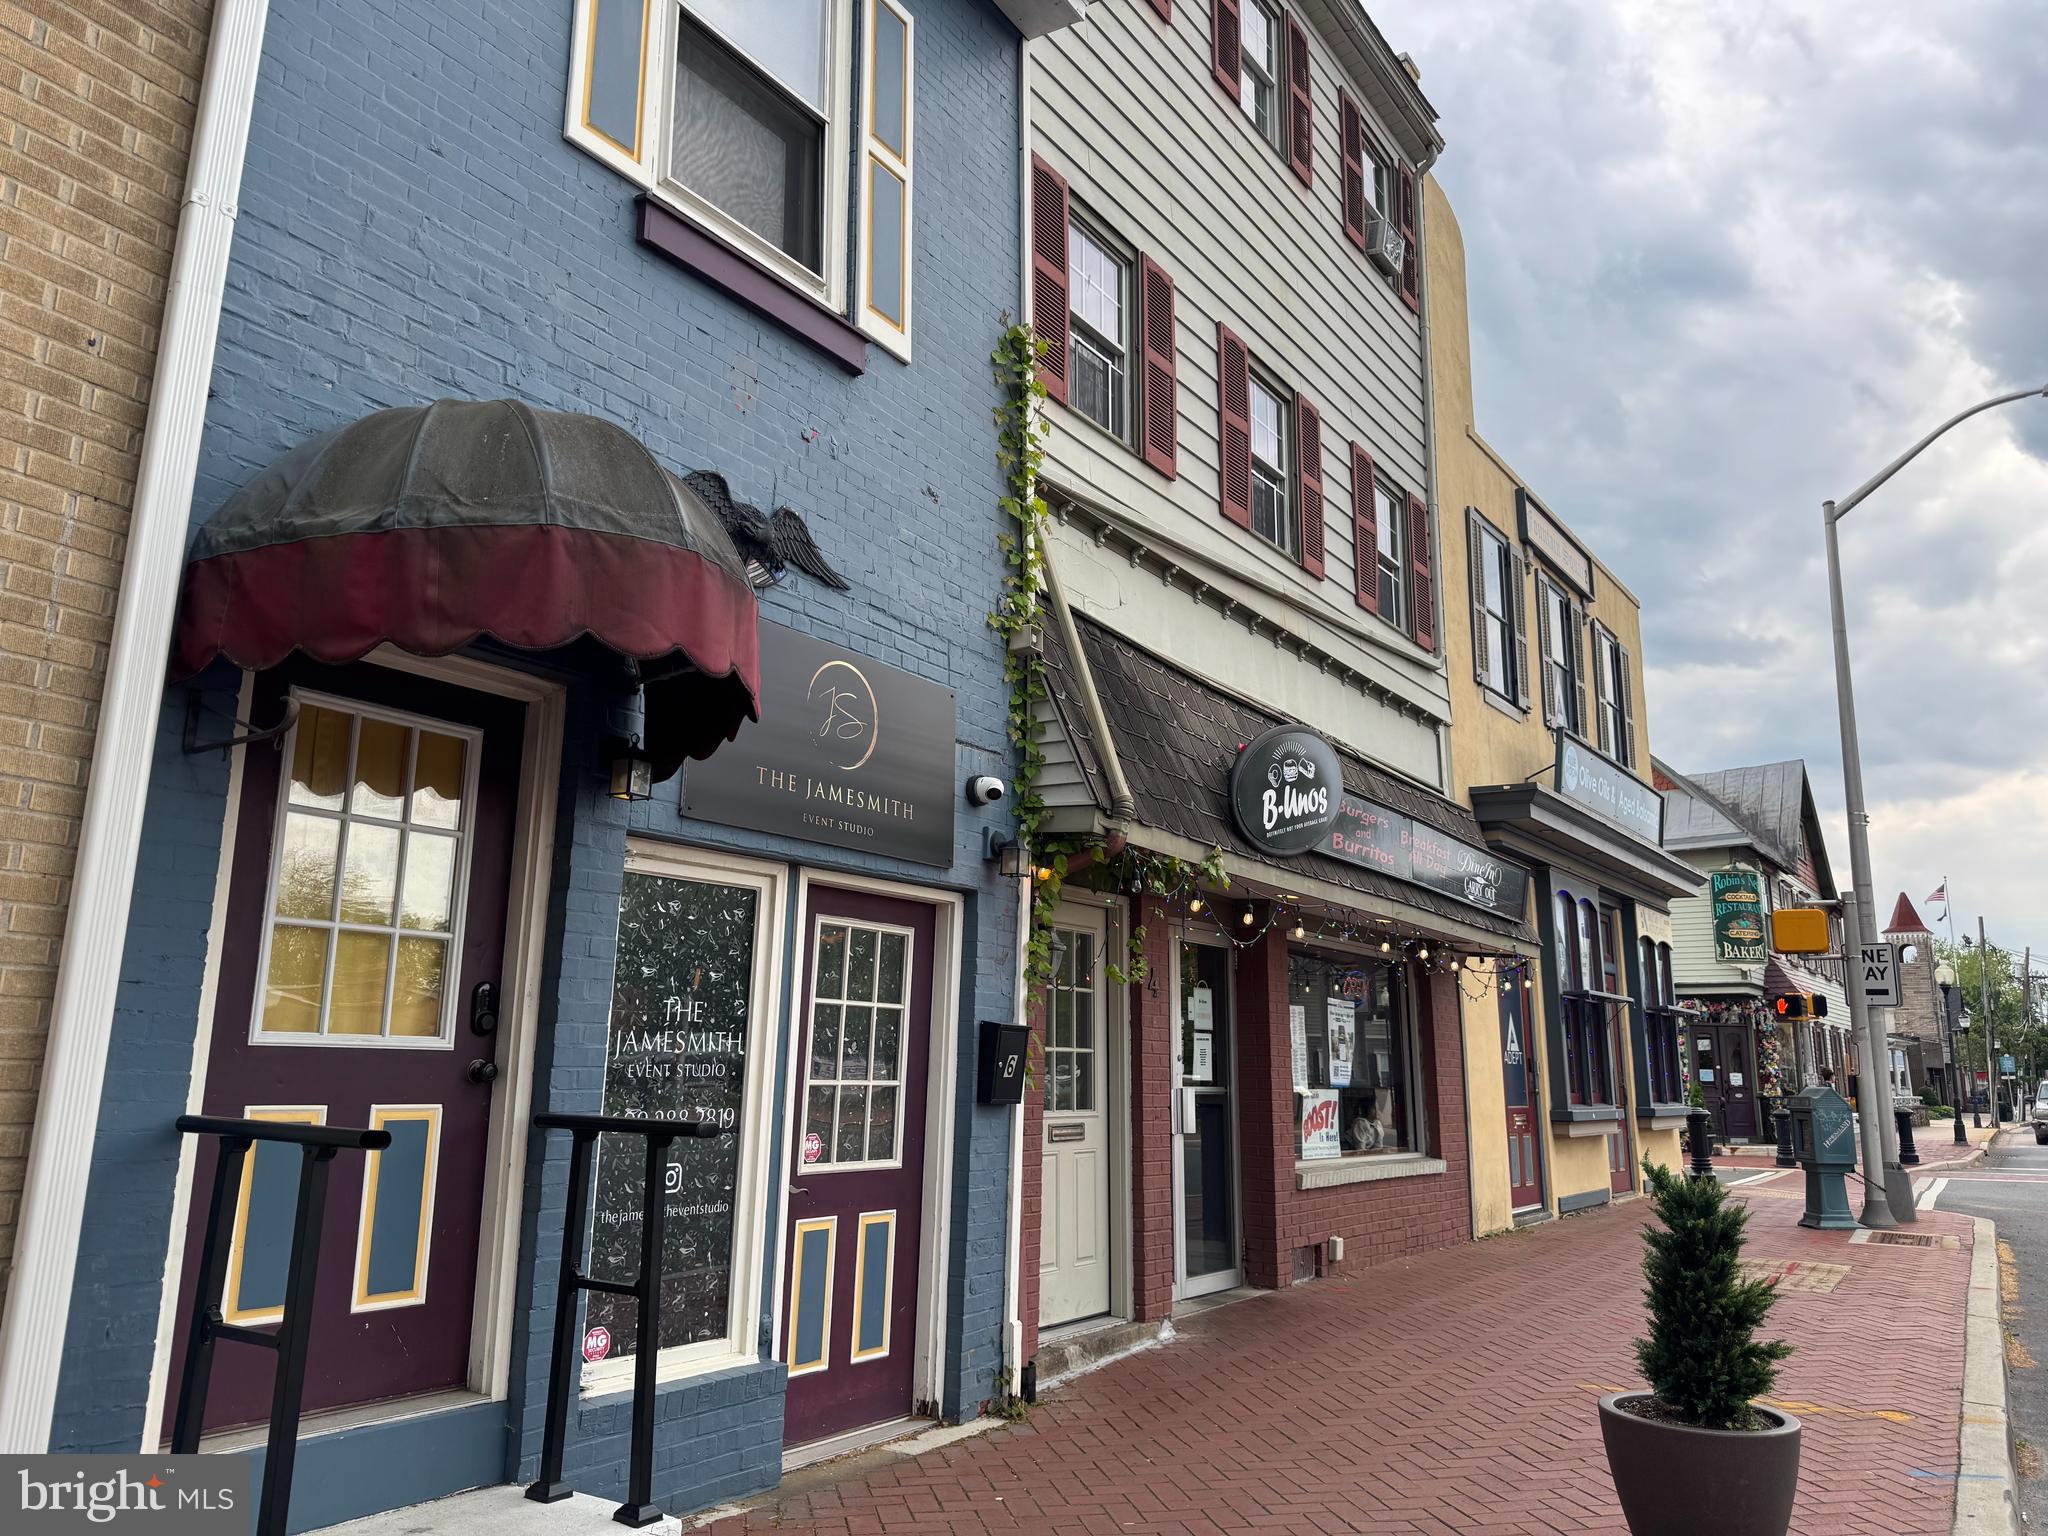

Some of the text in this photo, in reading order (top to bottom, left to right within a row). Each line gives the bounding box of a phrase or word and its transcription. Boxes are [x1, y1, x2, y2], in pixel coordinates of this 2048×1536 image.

[756, 766, 914, 820] THE JAMESMITH
[1579, 765, 1597, 792] Olive
[1598, 777, 1610, 801] Oils
[803, 813, 874, 837] EVENT STUDIO
[1340, 800, 1389, 829] Burgers
[1356, 828, 1371, 839] and
[1333, 832, 1394, 865] Burritos
[1400, 830, 1450, 861] Breakfast
[1408, 850, 1448, 878] All Day
[1723, 941, 1764, 959] BAKERY
[1861, 949, 1888, 963] NE
[1863, 966, 1888, 980] AY
[663, 1000, 704, 1022] THE
[613, 1030, 744, 1060] JAMESMITH
[1007, 1056, 1016, 1076] 6
[1504, 1051, 1523, 1064] ADEPT
[628, 1063, 726, 1078] EVENT STUDIO
[805, 1140, 819, 1150] MG
[587, 1334, 607, 1349] MG
